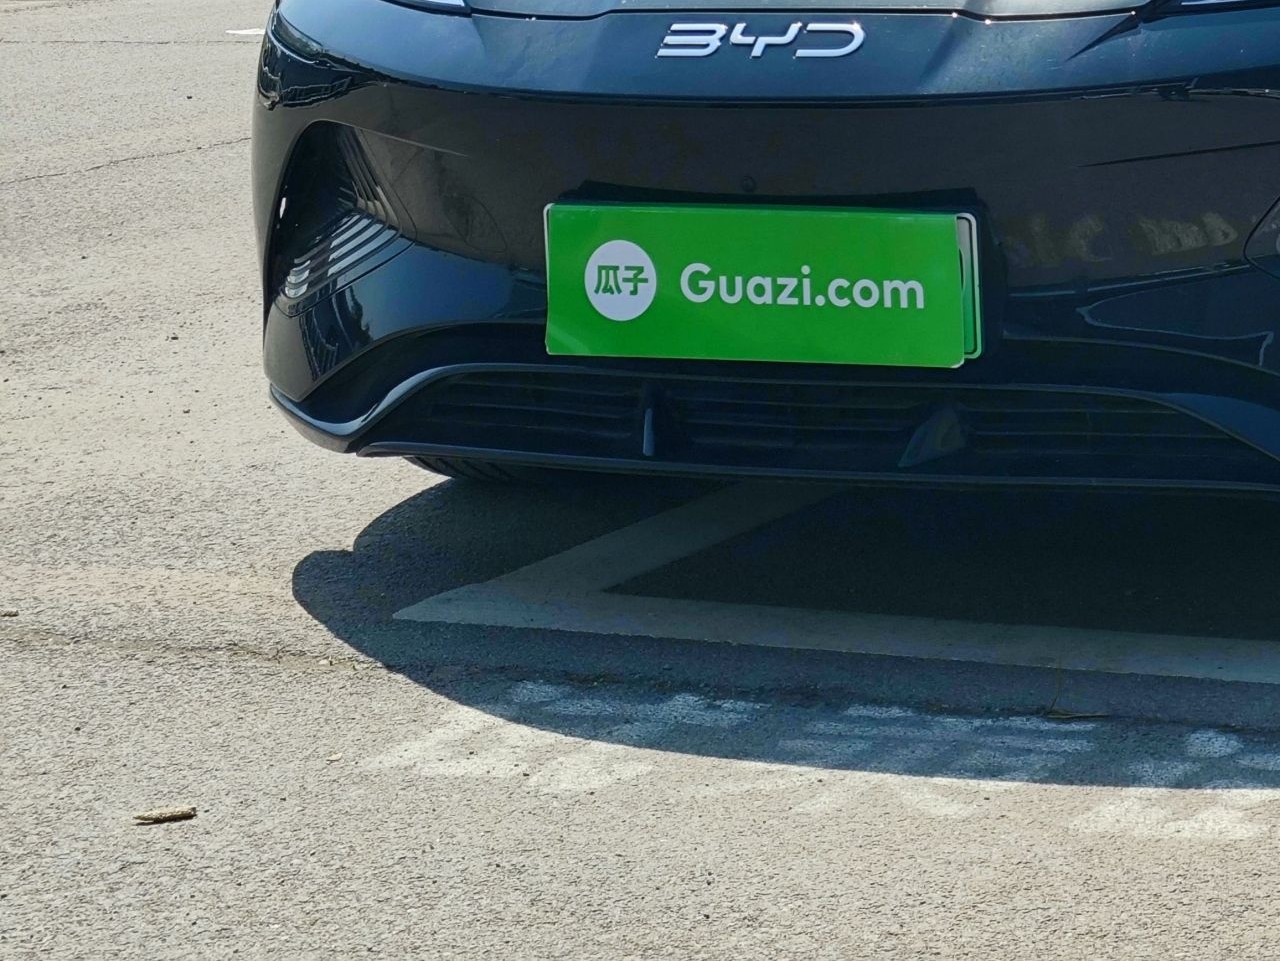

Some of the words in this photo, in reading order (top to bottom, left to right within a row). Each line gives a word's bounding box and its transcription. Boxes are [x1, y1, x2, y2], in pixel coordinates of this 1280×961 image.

[654, 20, 867, 60] BYD
[593, 264, 649, 296] 瓜子
[680, 263, 925, 310] Guazi.com
